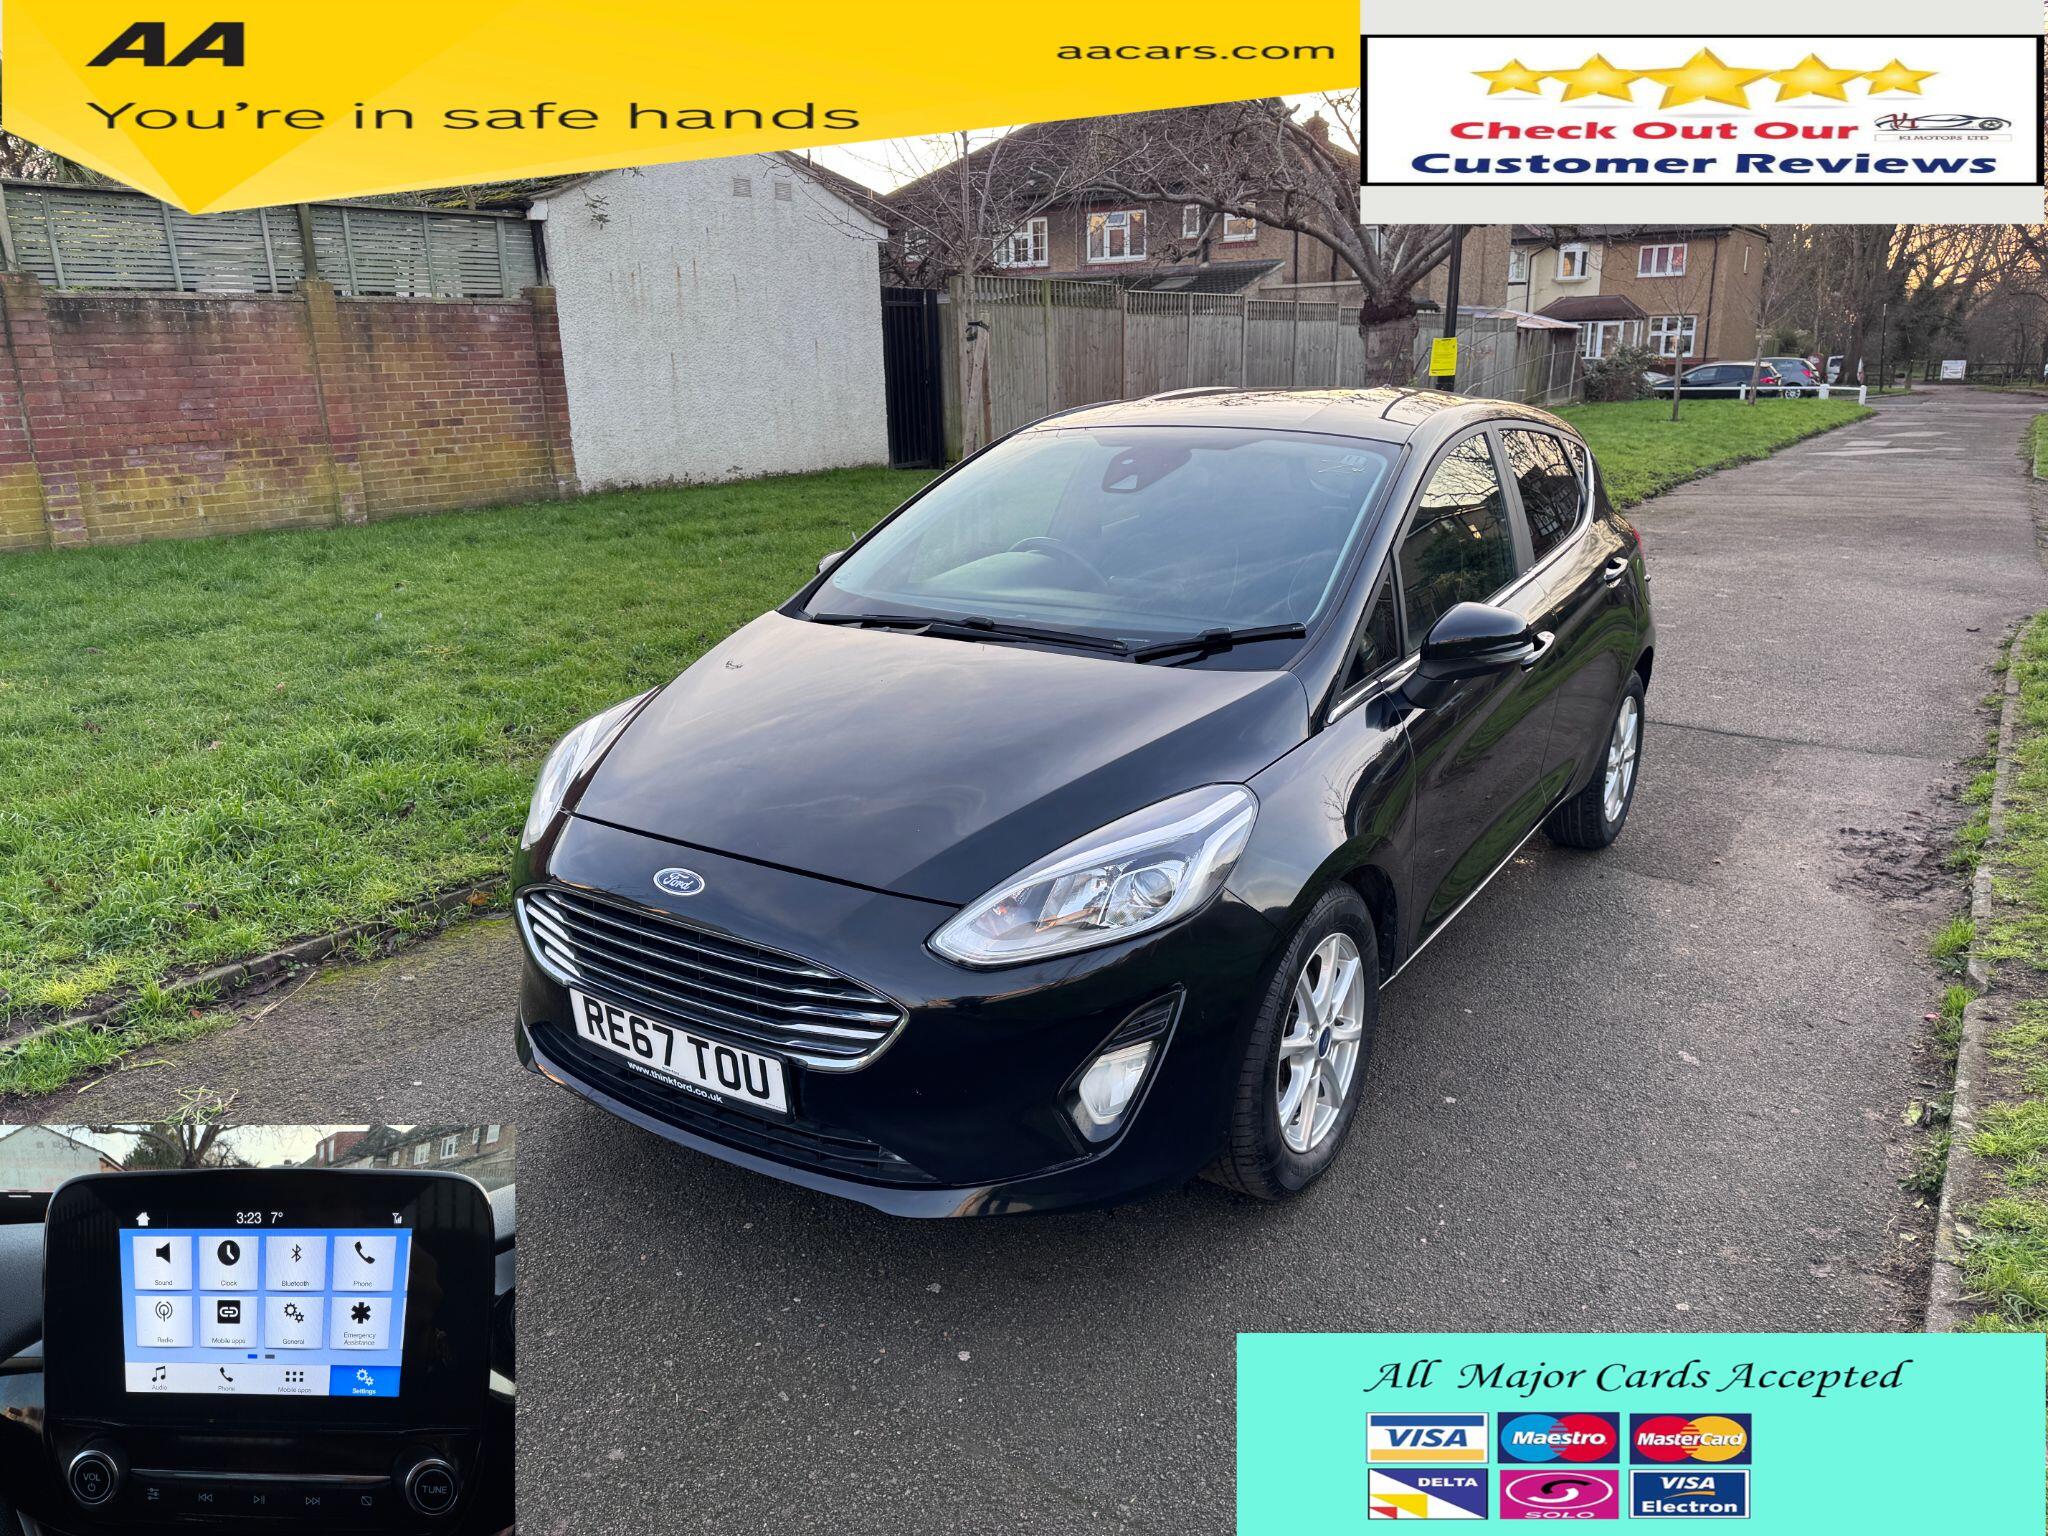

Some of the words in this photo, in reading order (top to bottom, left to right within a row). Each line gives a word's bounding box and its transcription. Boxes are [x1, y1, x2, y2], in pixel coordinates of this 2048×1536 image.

[662, 872, 694, 890] Ford
[582, 995, 674, 1067] RE67
[686, 1035, 771, 1100] TOU
[626, 1060, 724, 1104] www.thinkford.co.uk
[236, 1211, 262, 1225] 3:23
[281, 1280, 310, 1288] Bluetooth
[353, 1280, 373, 1288] Phone
[343, 1331, 377, 1340] Emergency
[157, 1336, 174, 1344] Radio
[211, 1337, 231, 1345] Mobile
[282, 1338, 305, 1346] General
[343, 1339, 375, 1347] Assistance
[151, 1384, 168, 1392] Audio
[217, 1385, 236, 1393] Phone
[352, 1387, 376, 1396] Settings
[83, 1472, 101, 1482] VOL
[422, 1485, 448, 1494] TUNE
